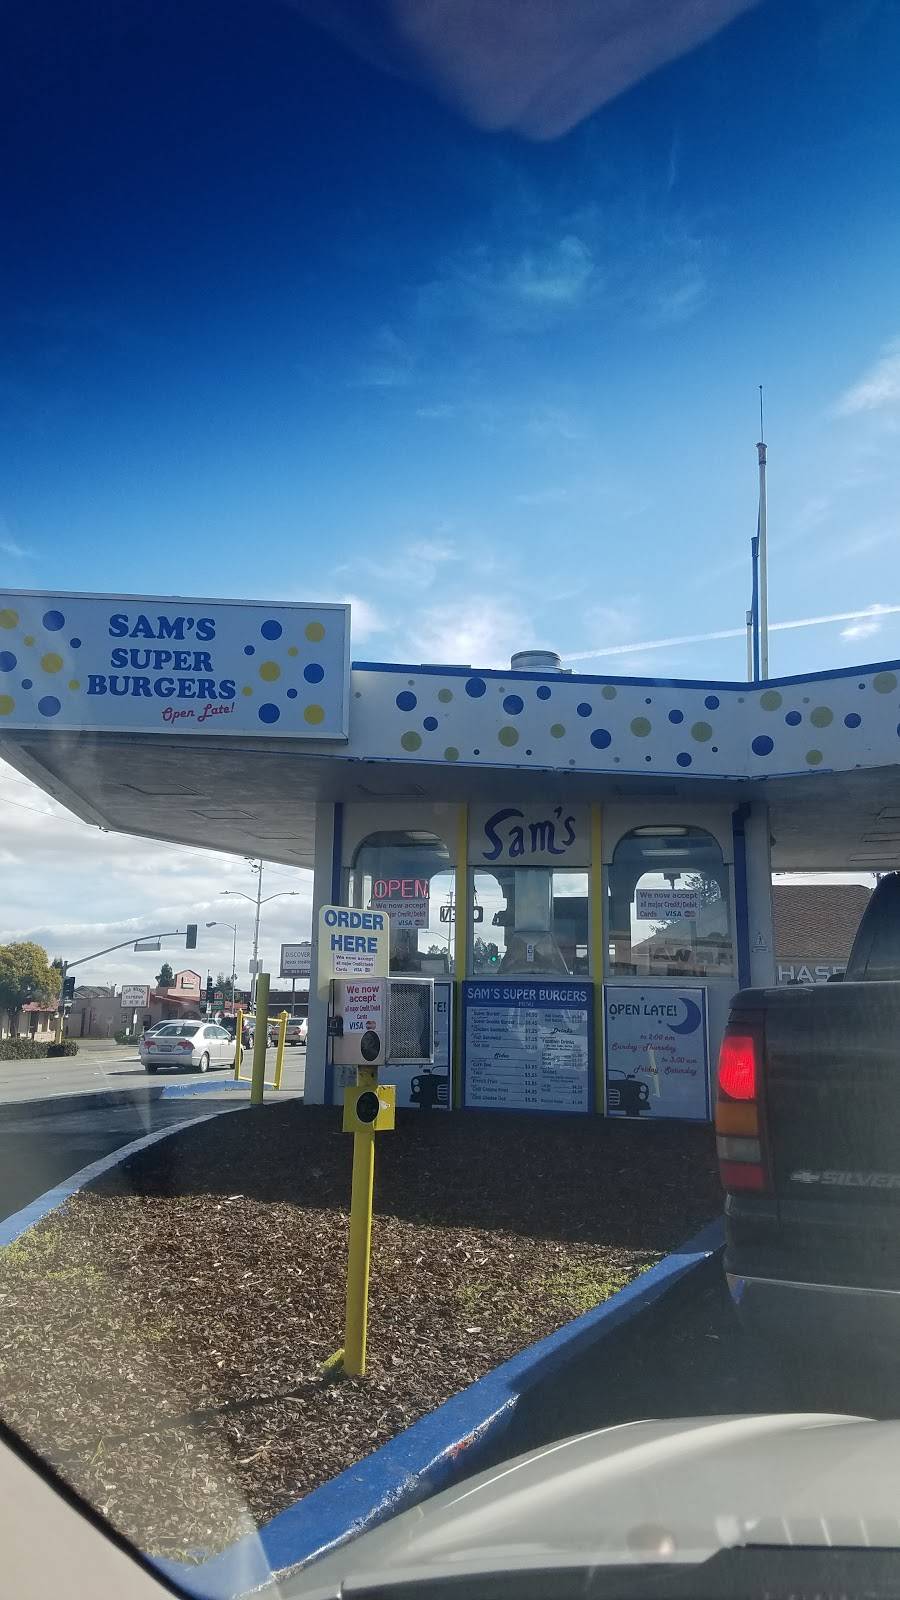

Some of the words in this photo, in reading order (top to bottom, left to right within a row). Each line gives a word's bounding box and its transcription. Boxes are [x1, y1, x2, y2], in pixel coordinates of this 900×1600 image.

[109, 614, 216, 641] SAM'S
[110, 648, 214, 672] SUPER
[86, 675, 236, 700] BURGERS
[162, 707, 195, 723] Open
[198, 702, 235, 722] Late!
[482, 806, 576, 860] Sam's
[374, 879, 428, 898] OPEN
[672, 892, 698, 900] accept
[404, 902, 426, 910] accept
[324, 910, 384, 930] ORDER
[331, 935, 378, 953] HERE
[346, 985, 360, 994] We
[350, 994, 377, 1003] accept
[468, 988, 500, 999] SAM'S
[503, 989, 536, 1000] SUPER
[540, 990, 587, 1002] BURGERS
[609, 1004, 640, 1015] OPEN
[644, 1004, 678, 1016] LATE!
[350, 1022, 364, 1030] VISA
